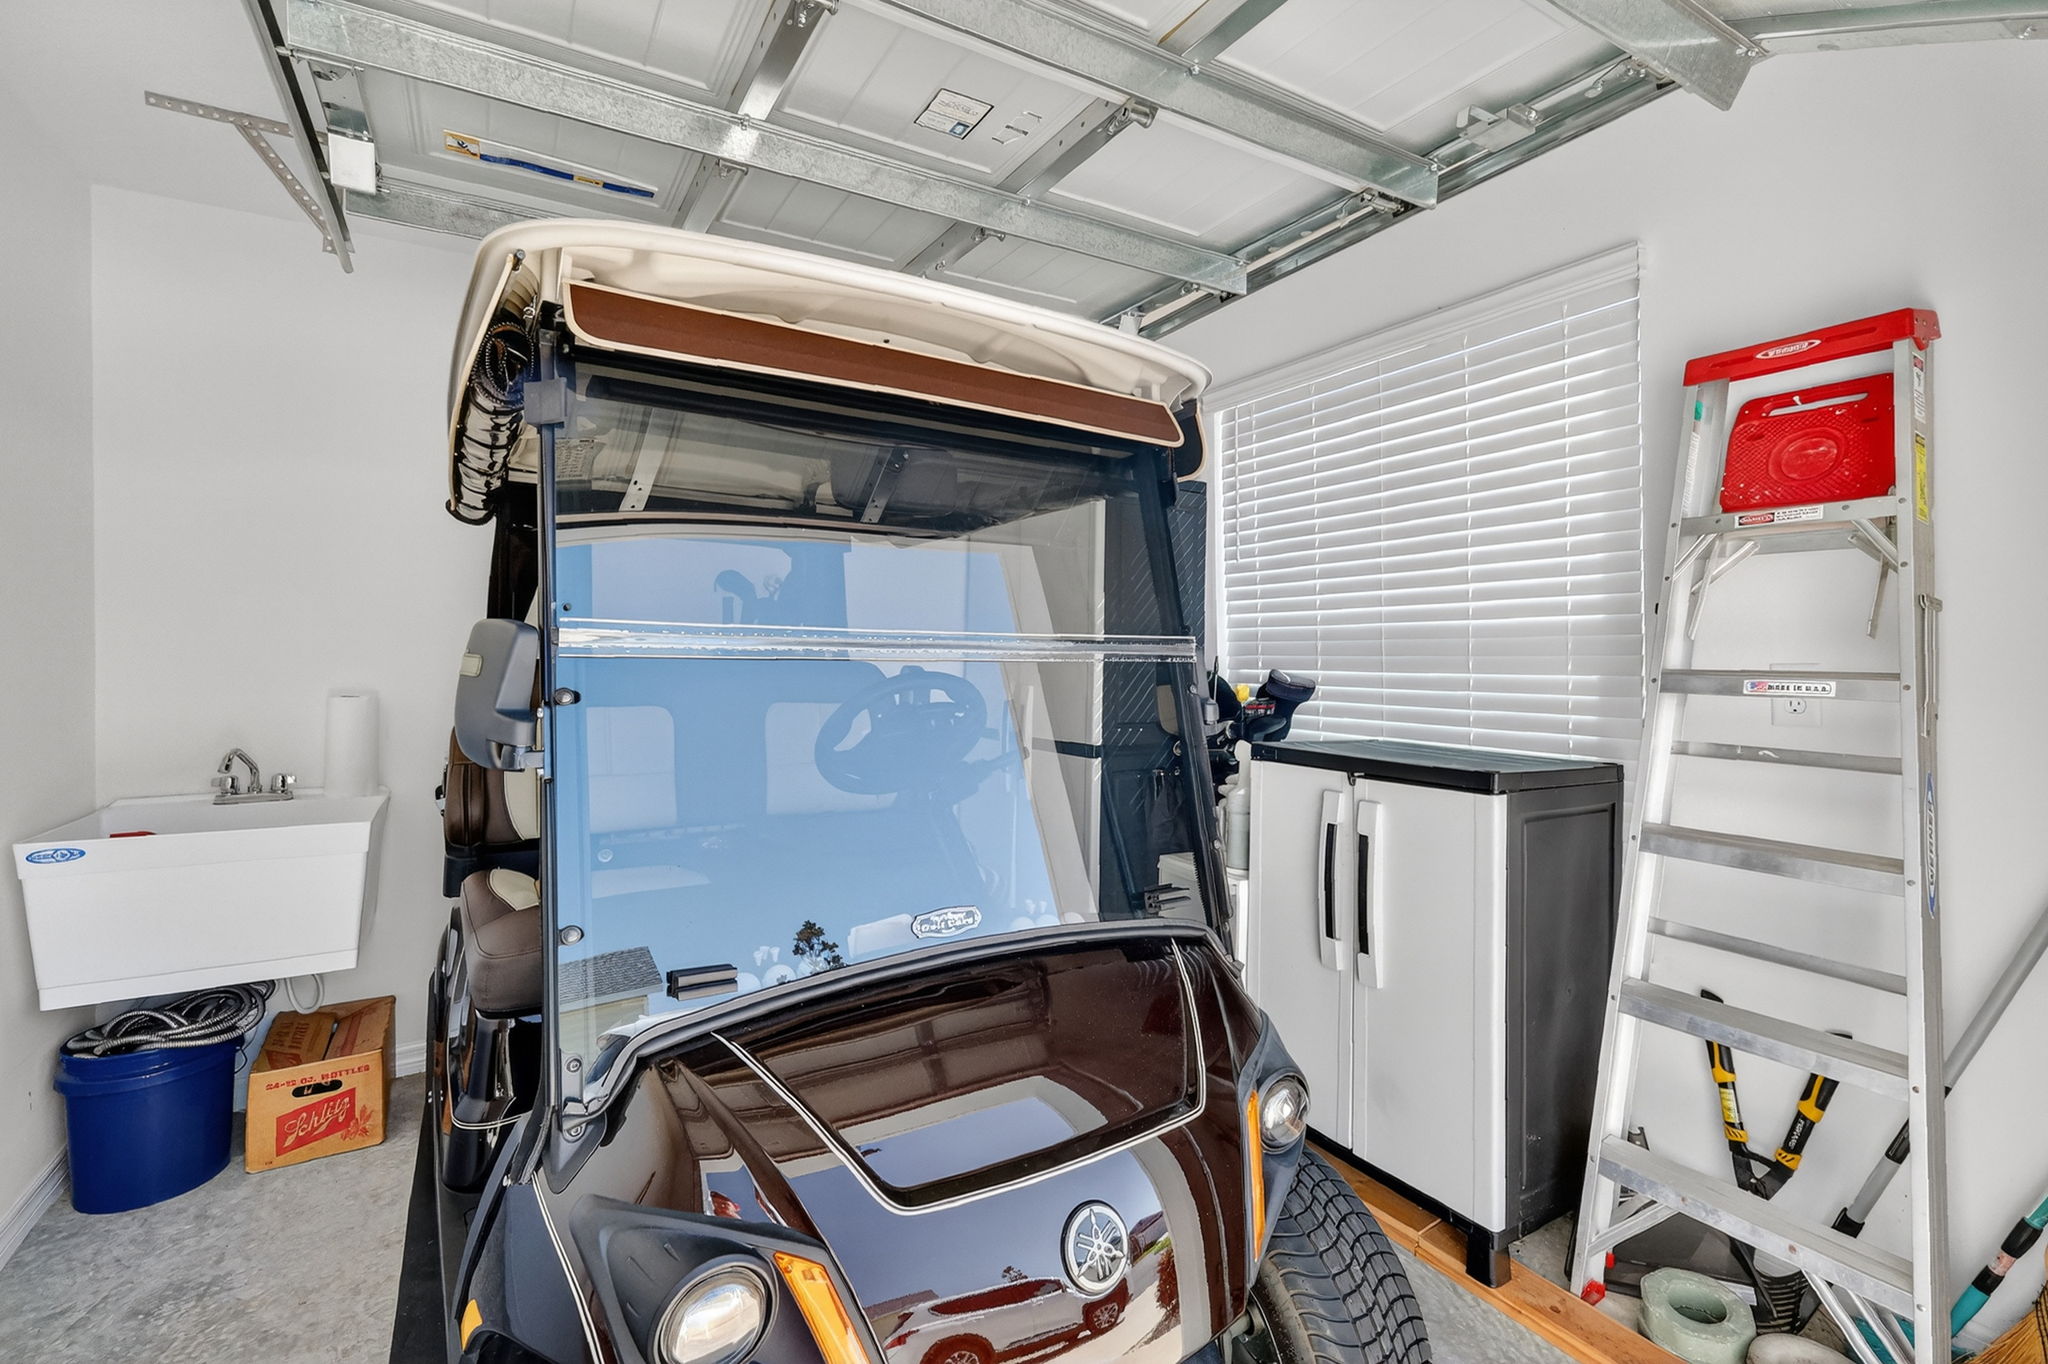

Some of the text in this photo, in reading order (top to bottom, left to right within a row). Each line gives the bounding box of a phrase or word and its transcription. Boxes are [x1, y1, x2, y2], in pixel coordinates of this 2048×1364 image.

[1927, 800, 1937, 887] WERNER
[320, 1064, 370, 1081] BOTTLES
[282, 1096, 351, 1148] Schlitz
